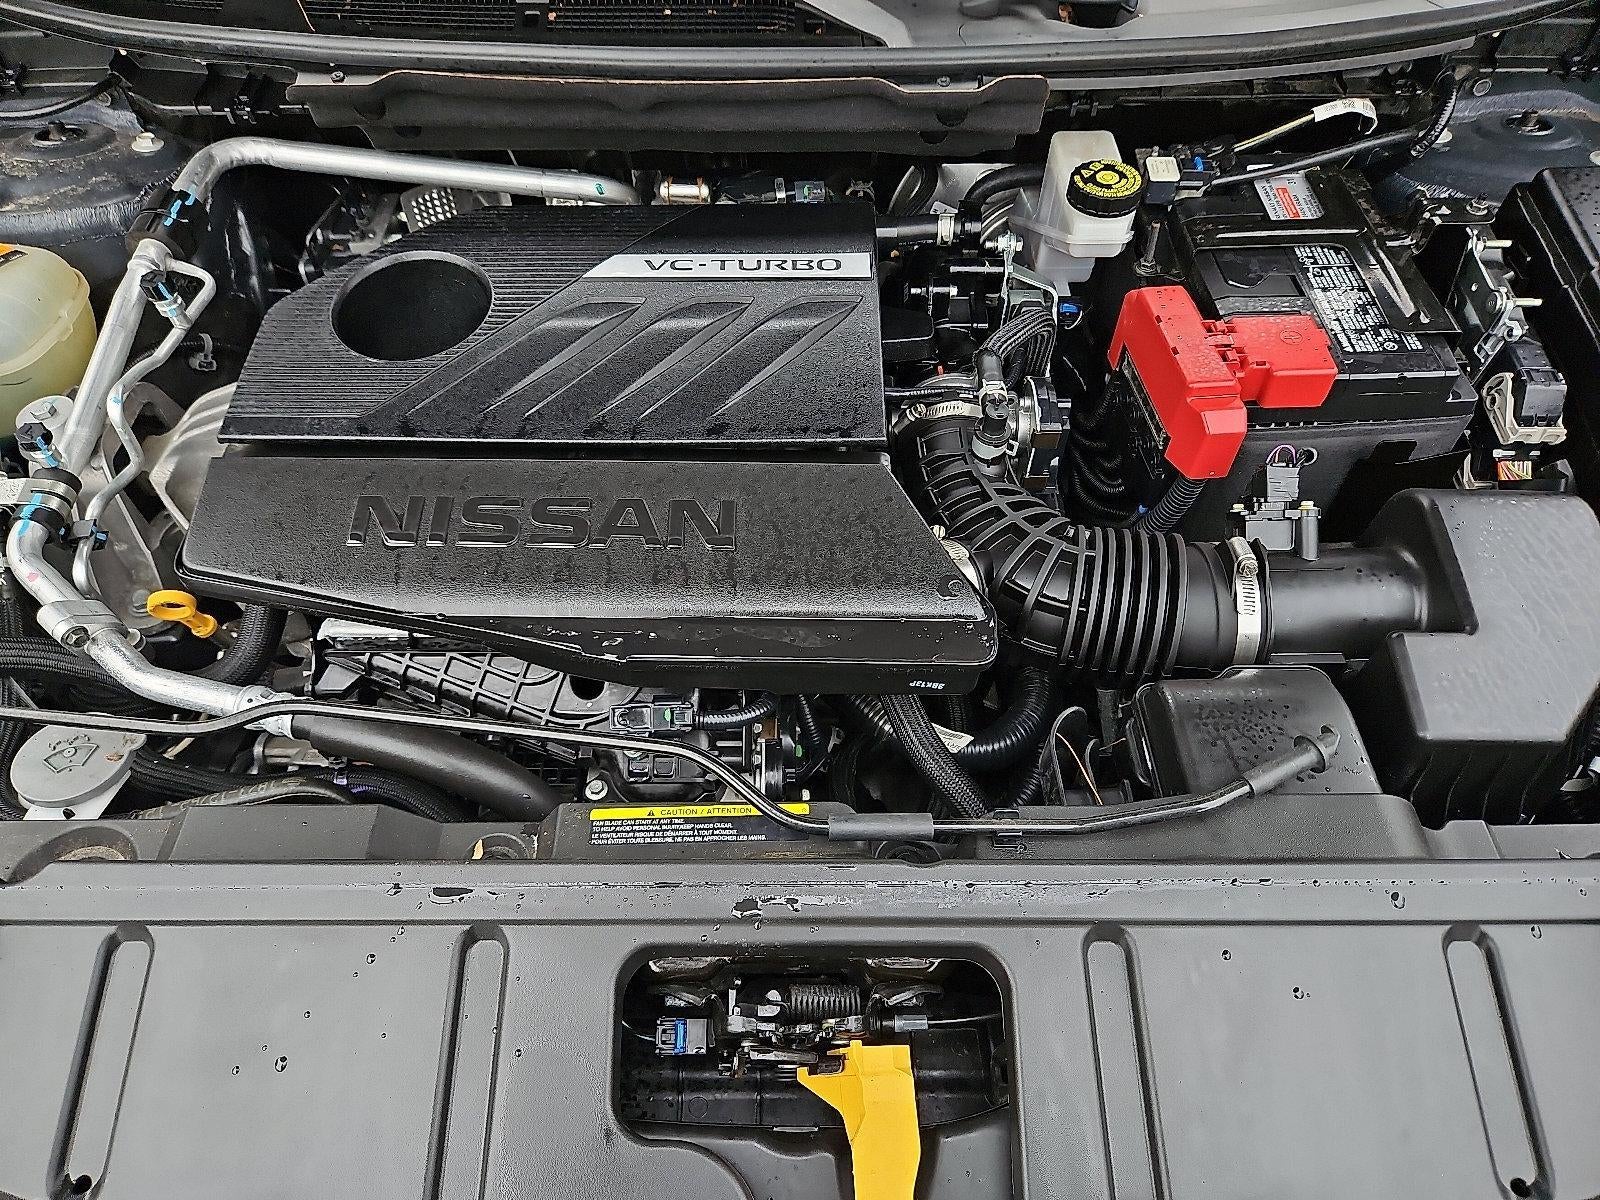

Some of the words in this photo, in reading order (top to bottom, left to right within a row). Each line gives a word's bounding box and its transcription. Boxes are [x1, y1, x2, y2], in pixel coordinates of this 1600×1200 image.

[643, 258, 842, 272] VC-TURBO
[346, 494, 738, 550] NISSAN
[660, 808, 698, 816] CAUTION
[706, 807, 752, 815] ATTENTION
